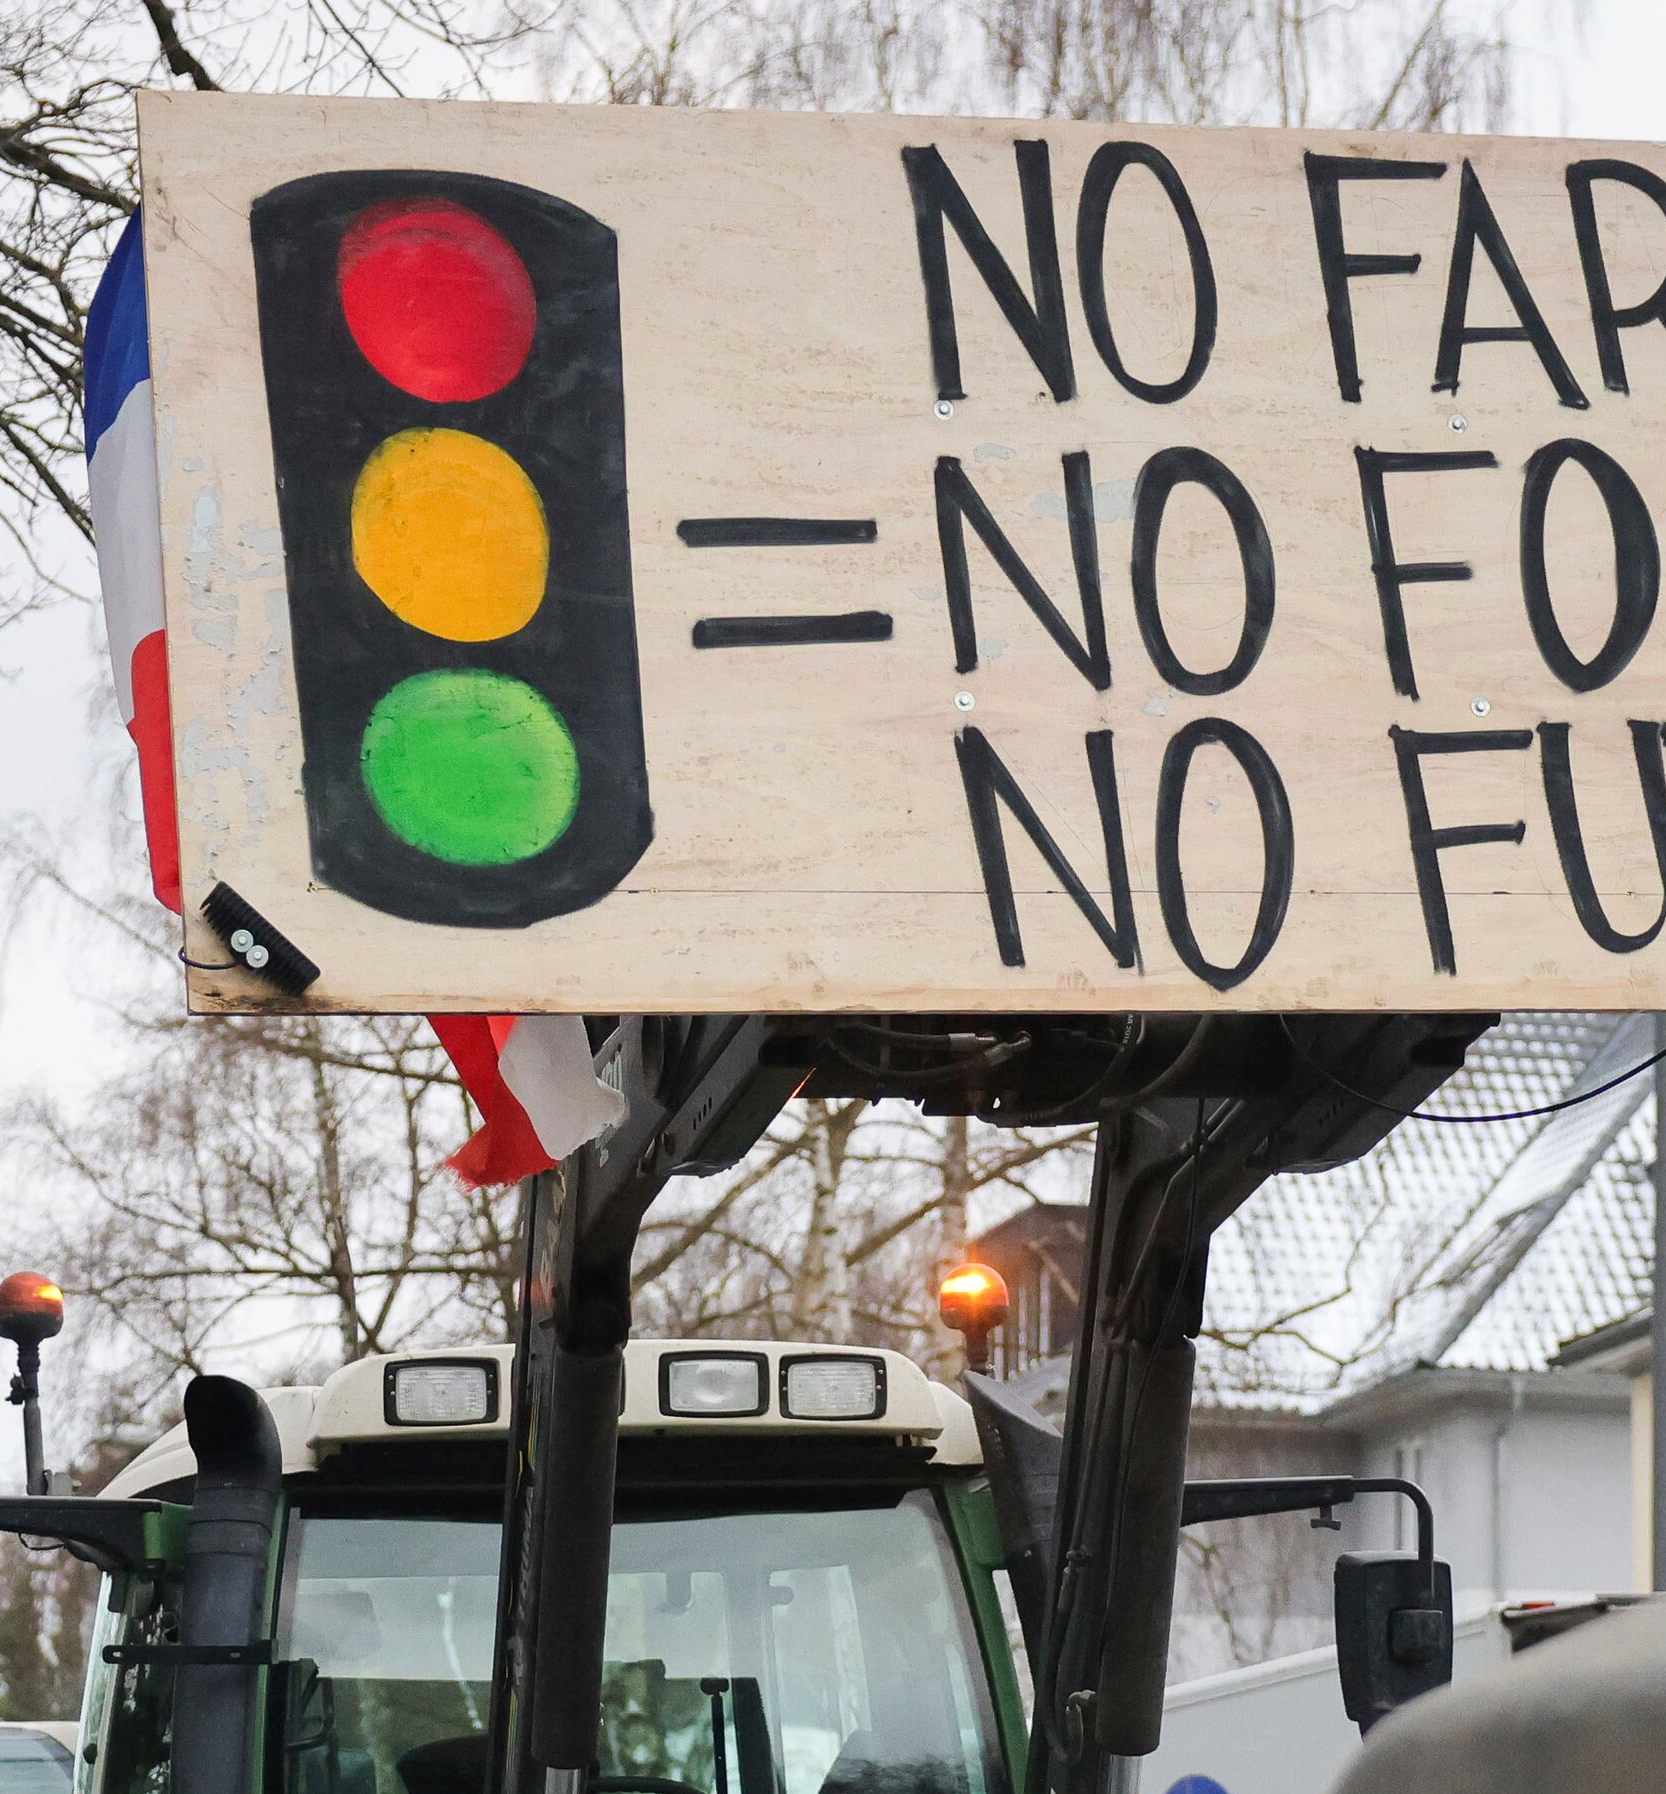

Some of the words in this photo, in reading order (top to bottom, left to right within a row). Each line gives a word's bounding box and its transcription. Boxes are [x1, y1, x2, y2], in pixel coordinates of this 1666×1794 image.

[901, 139, 1218, 404] NO
[933, 446, 1276, 696] NO
[954, 717, 1295, 992] NO
